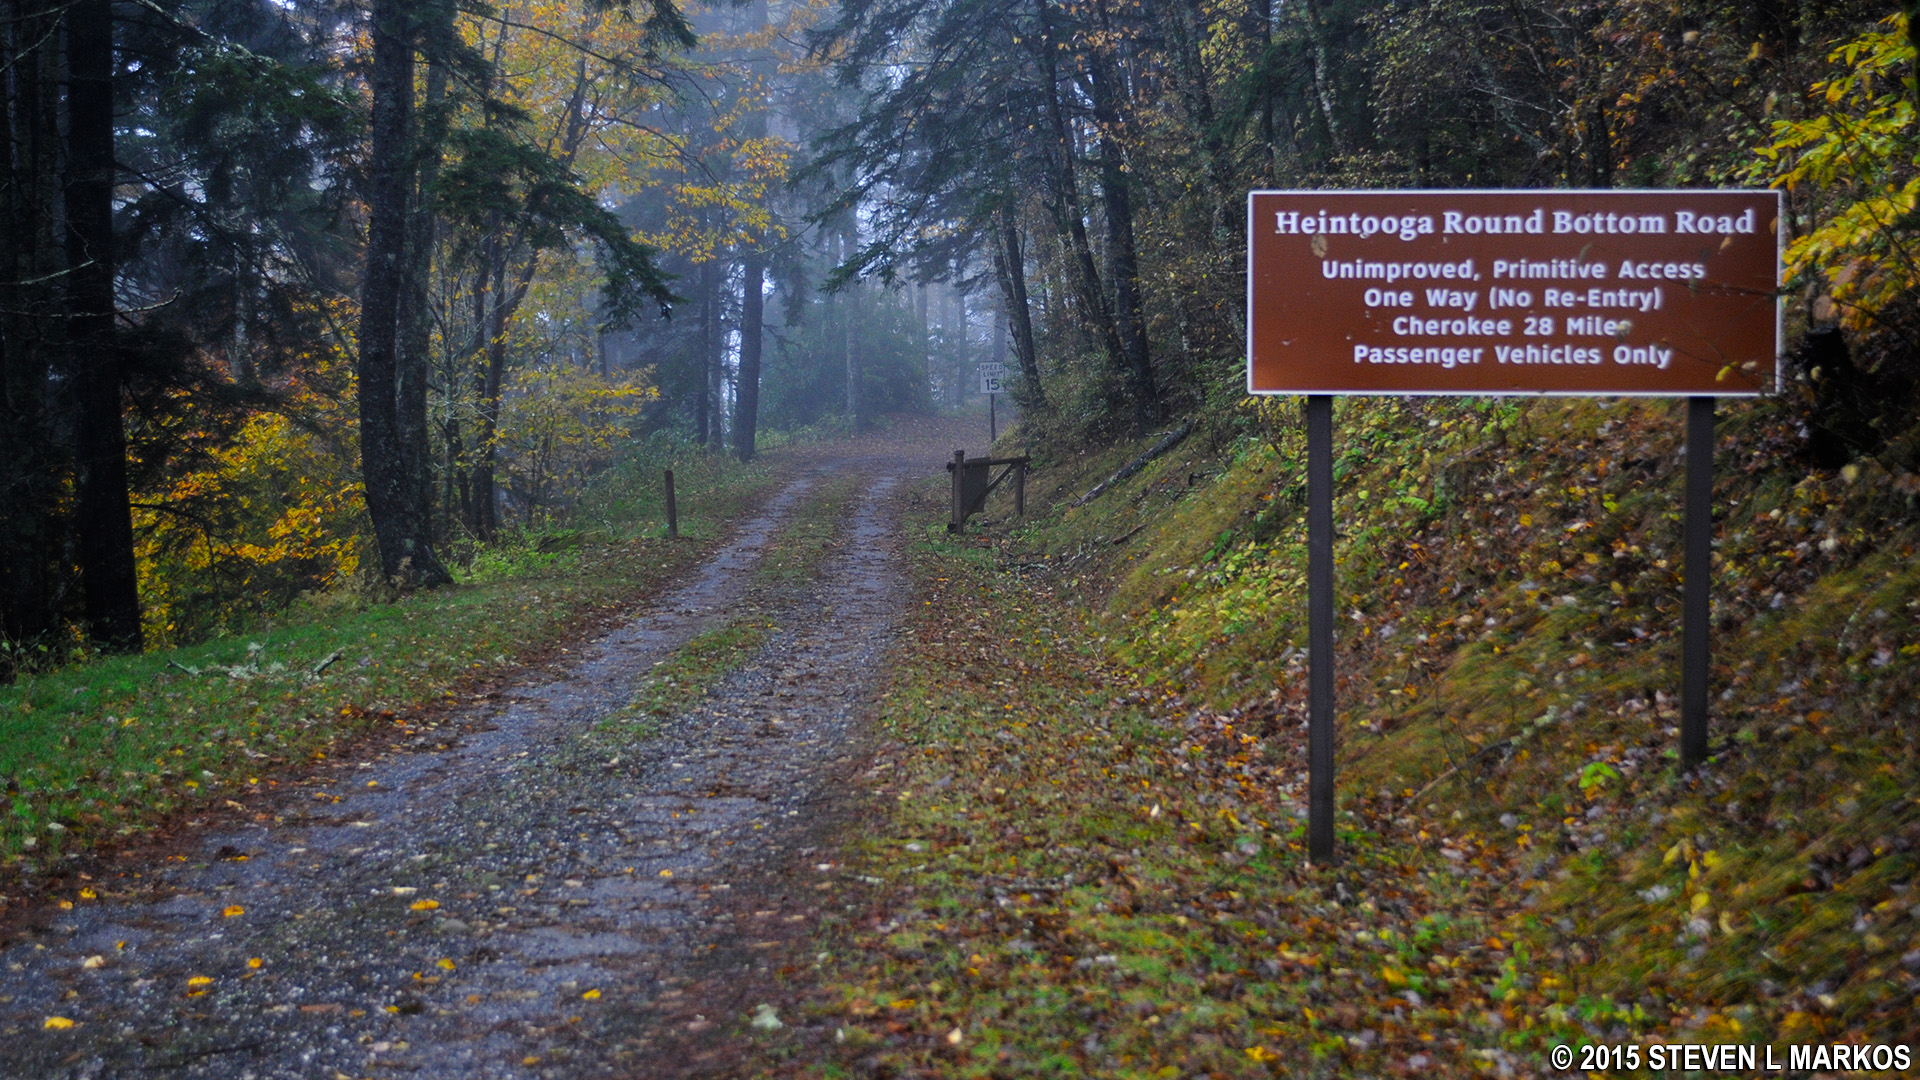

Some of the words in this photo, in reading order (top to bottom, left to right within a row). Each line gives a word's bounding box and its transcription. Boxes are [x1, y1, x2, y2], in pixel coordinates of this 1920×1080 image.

[1275, 209, 1435, 241] Heintooga
[1442, 208, 1545, 235] Round
[1551, 211, 1666, 235] Bottom
[1675, 208, 1755, 235] Road
[1321, 258, 1481, 283] Unimproved,
[1493, 258, 1606, 280] Primitive
[1617, 259, 1706, 280] Access
[1363, 288, 1415, 308] One
[1425, 288, 1478, 312] Way
[1488, 286, 1533, 310] (No
[1544, 286, 1664, 312] Re-Entry)
[1392, 315, 1513, 336] Cherokee
[1523, 317, 1555, 336] 28
[1353, 344, 1483, 369] Passenger
[1494, 344, 1603, 365] Vehicles
[1613, 345, 1673, 370] Only
[985, 378, 1000, 391] 15
